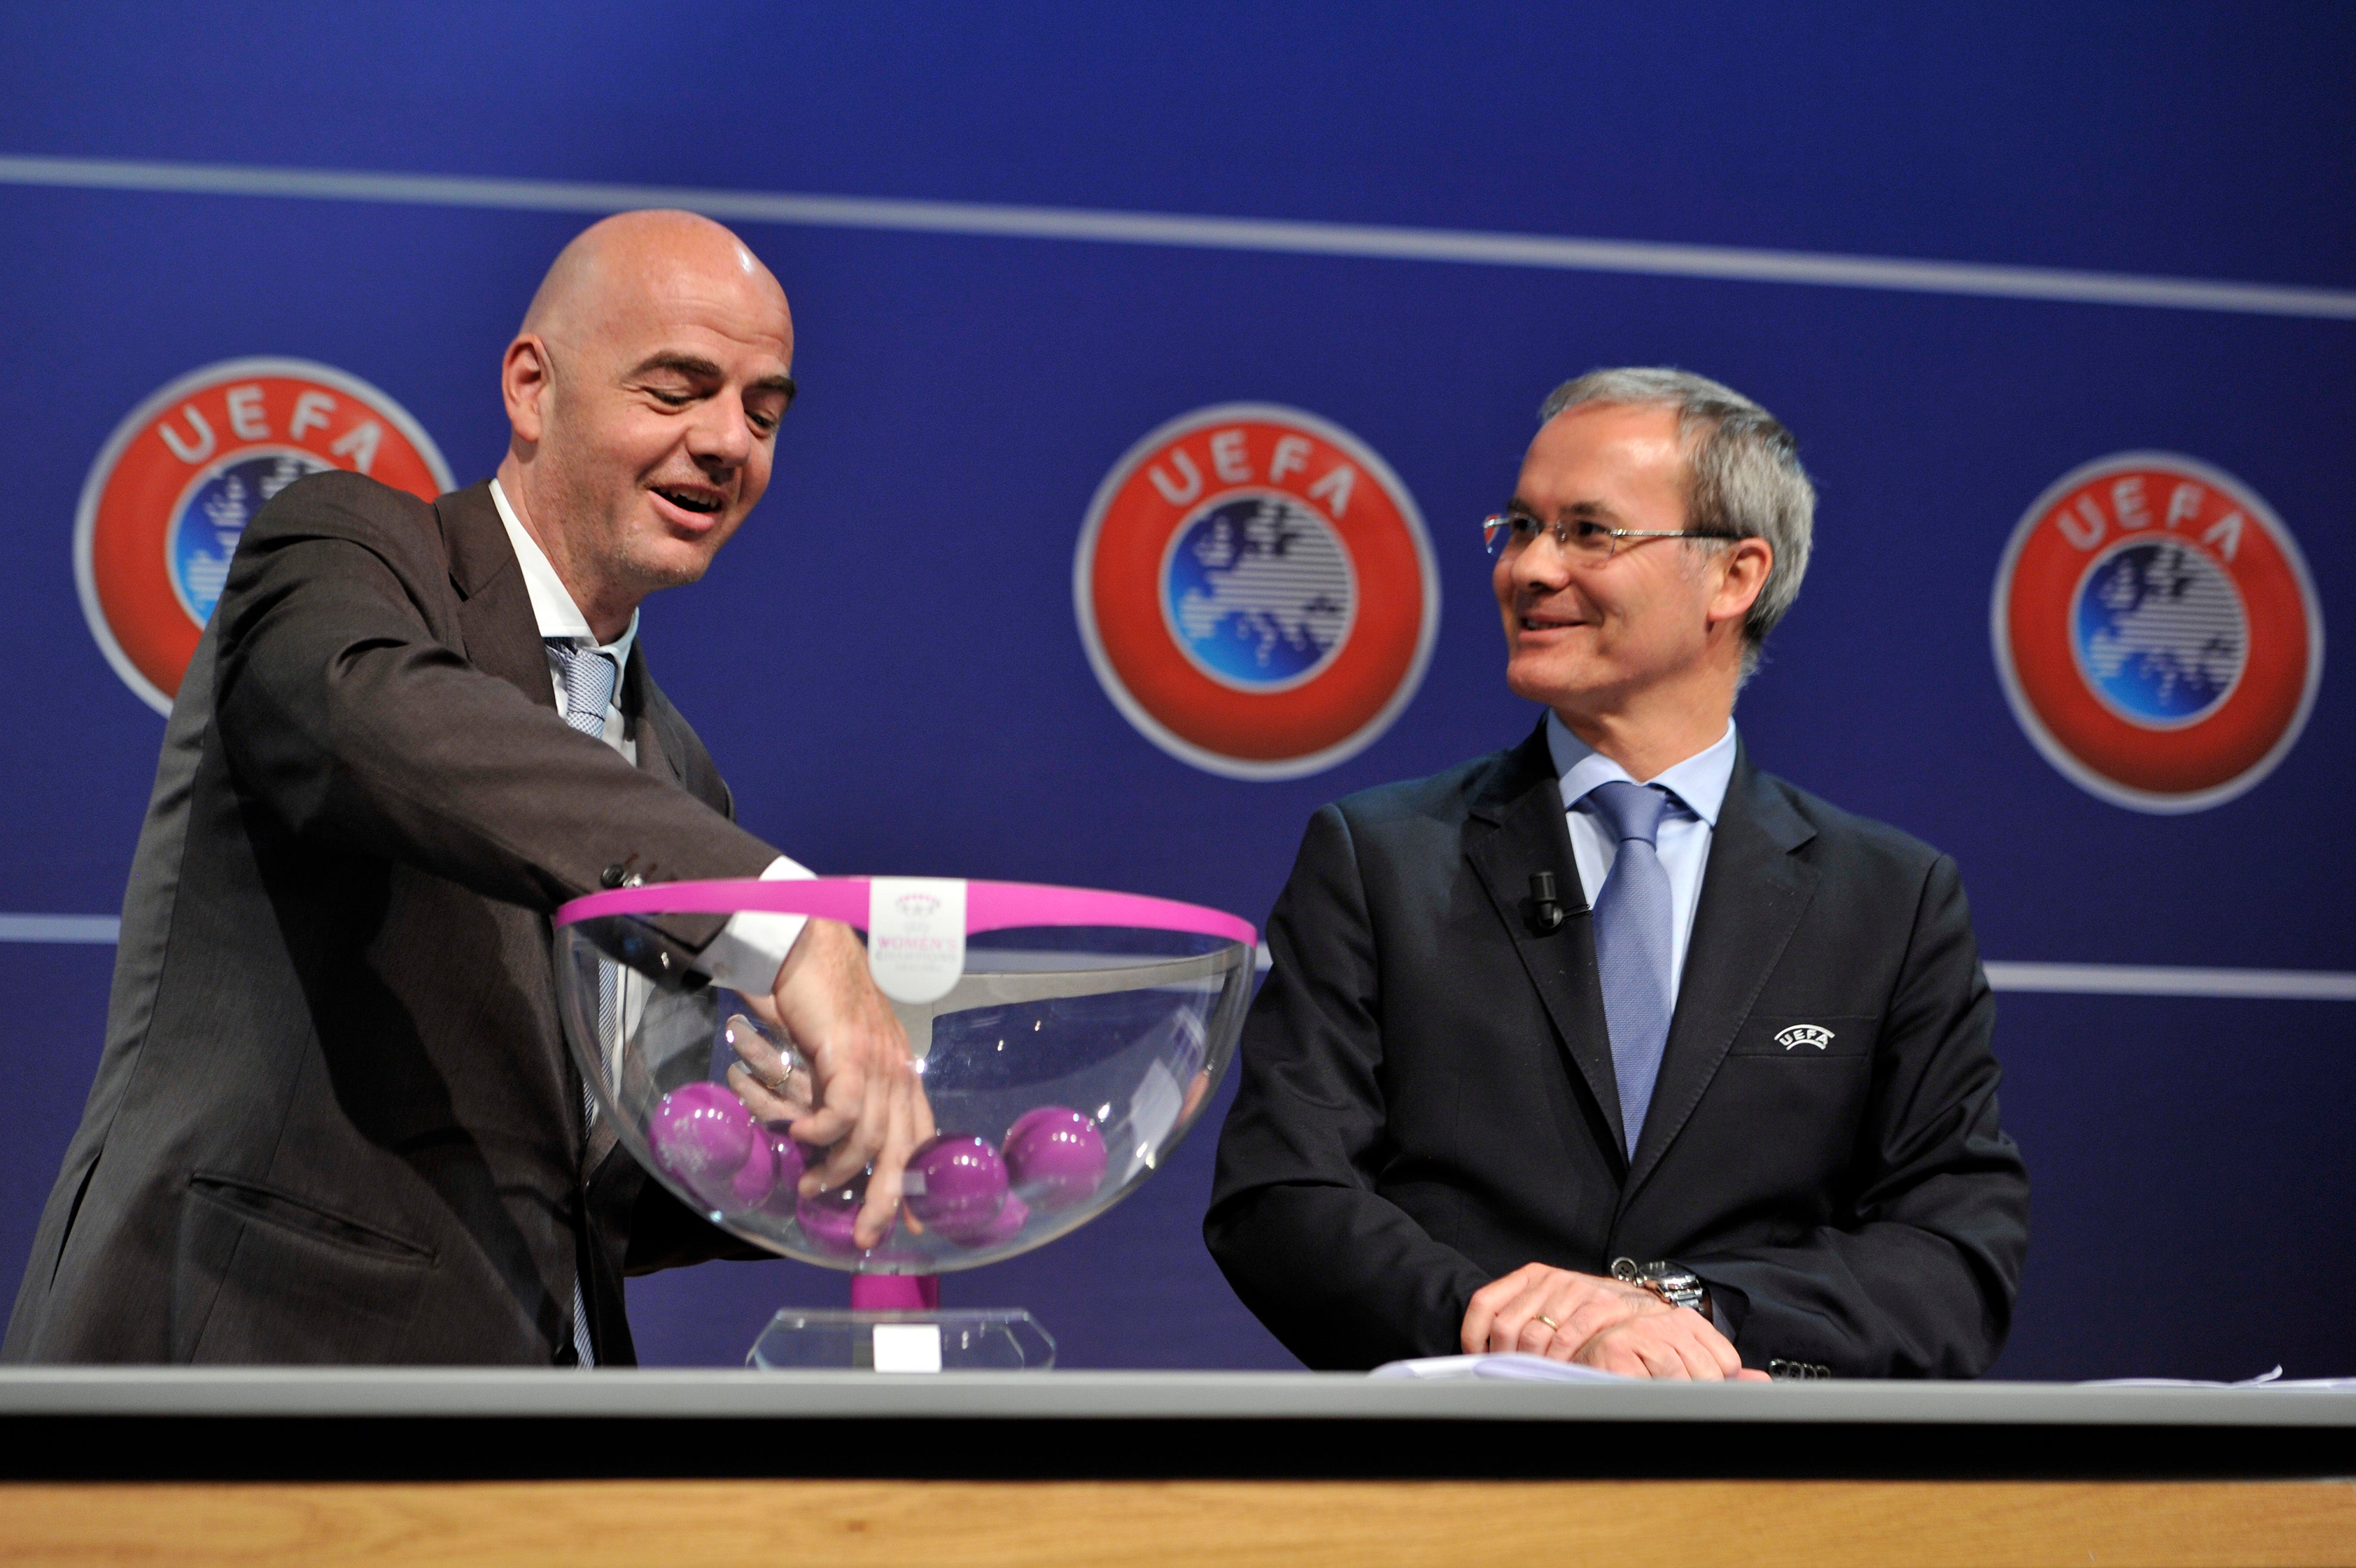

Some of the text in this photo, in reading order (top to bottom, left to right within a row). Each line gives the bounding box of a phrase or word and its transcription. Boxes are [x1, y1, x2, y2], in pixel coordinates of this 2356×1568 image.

[158, 384, 386, 476] UEFA
[1148, 429, 1356, 518] UEFA
[2056, 475, 2245, 562] UEFA
[1779, 1029, 1828, 1046] UEFA
